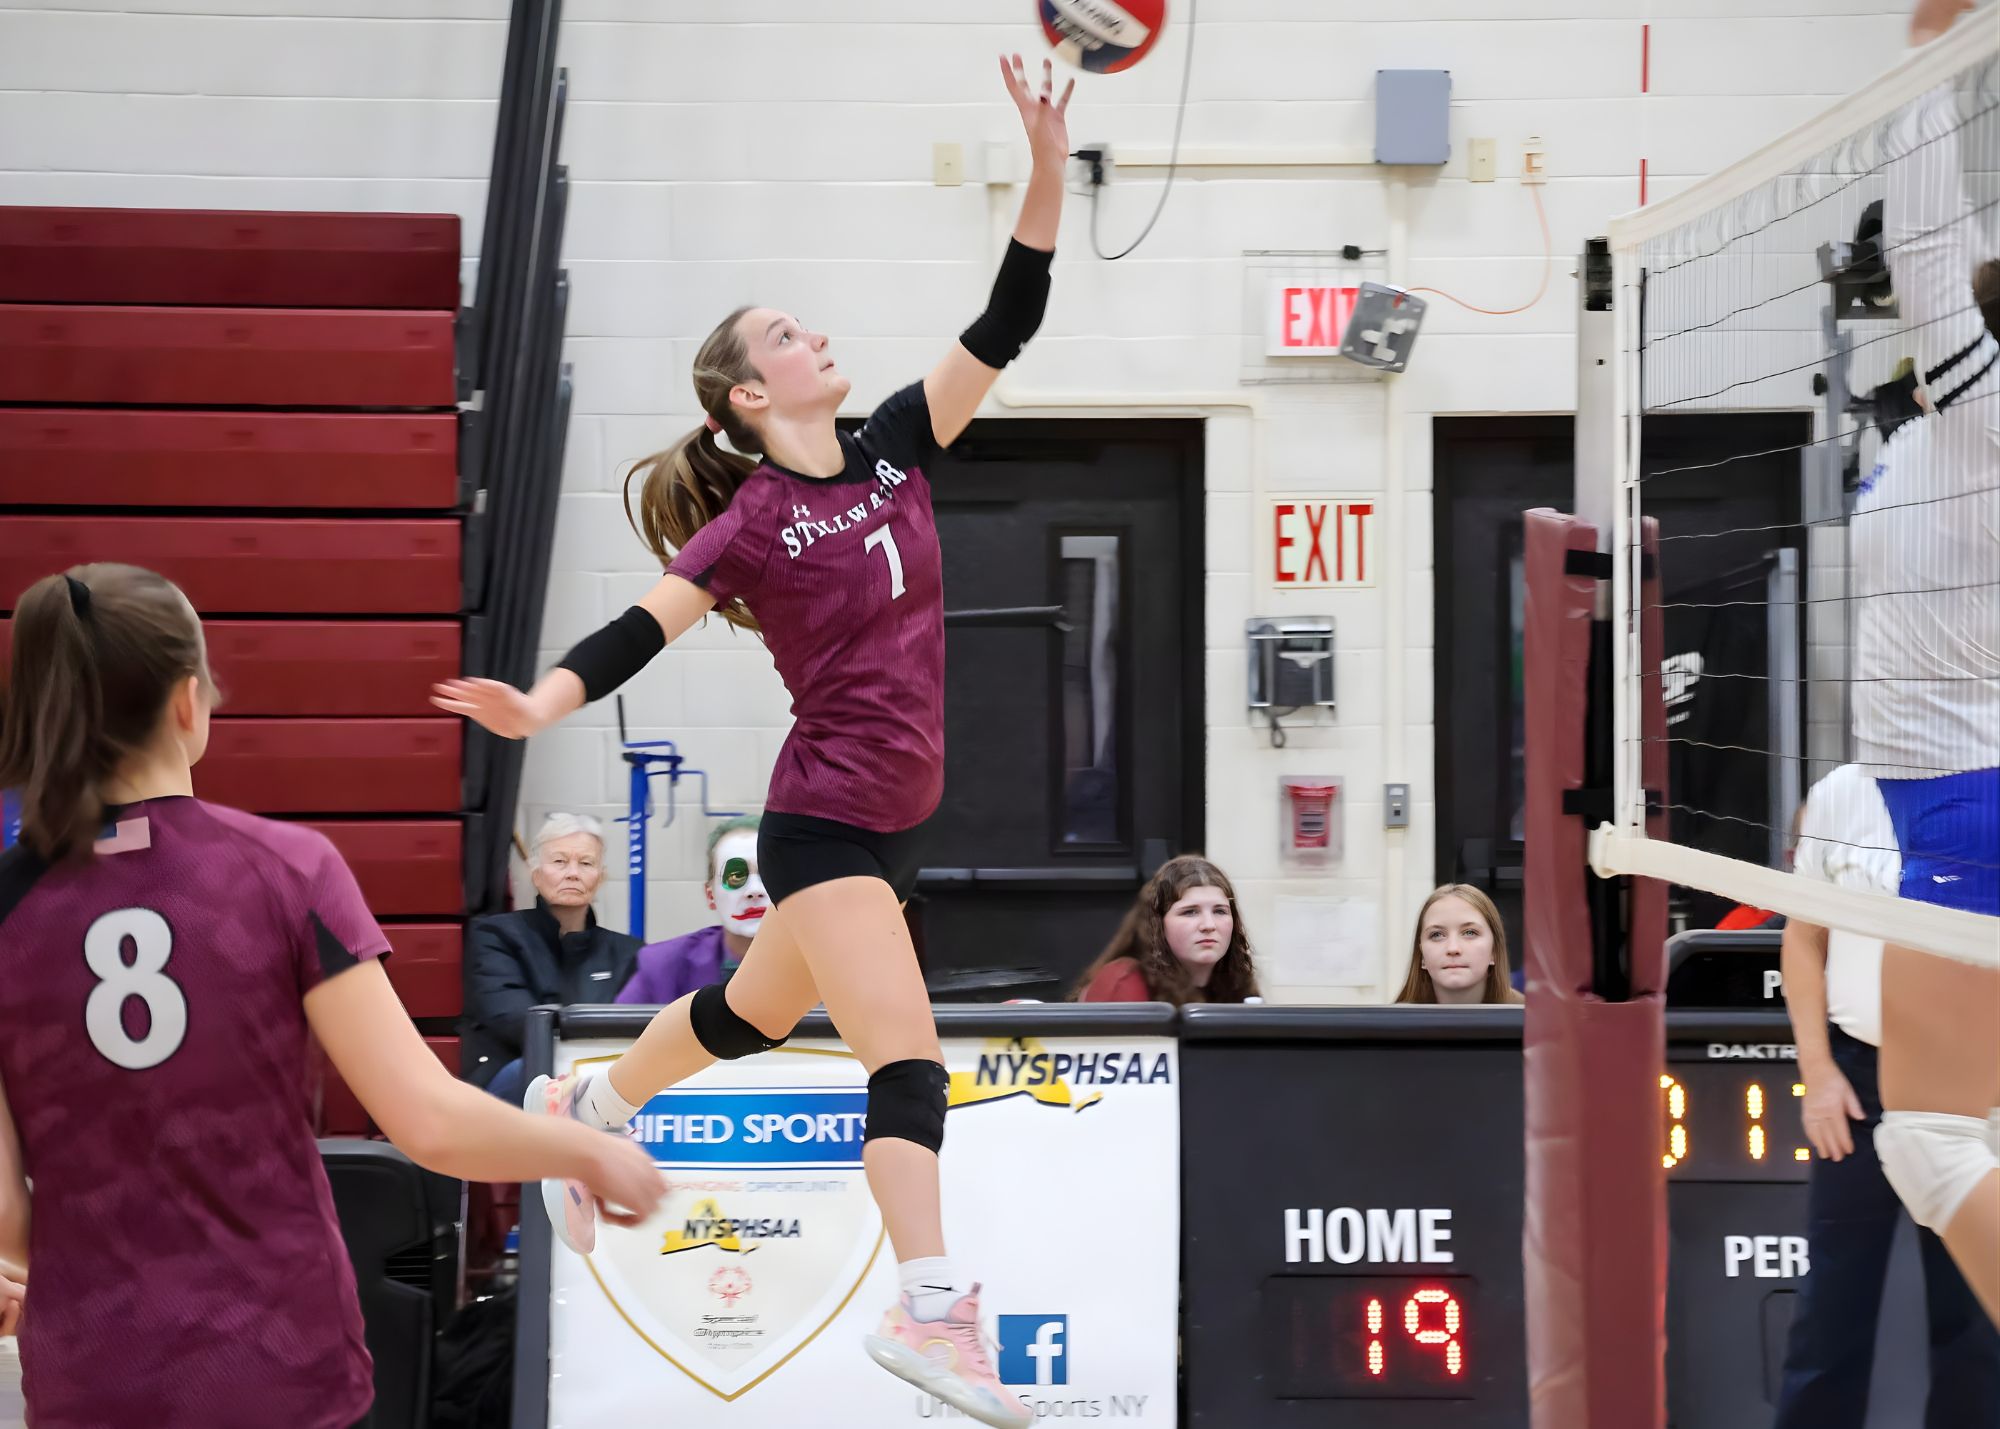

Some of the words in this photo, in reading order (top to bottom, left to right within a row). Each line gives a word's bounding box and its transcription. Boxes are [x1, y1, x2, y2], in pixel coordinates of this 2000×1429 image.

[864, 523, 906, 600] 7
[1274, 504, 1373, 582] EXIT
[84, 907, 187, 1070] 8
[976, 1053, 1171, 1086] NYSPHSAA
[683, 1219, 802, 1240] NYSPHSAA
[1284, 1207, 1454, 1264] HOME
[1366, 1290, 1462, 1375] 19
[1110, 1395, 1149, 1418] NY
